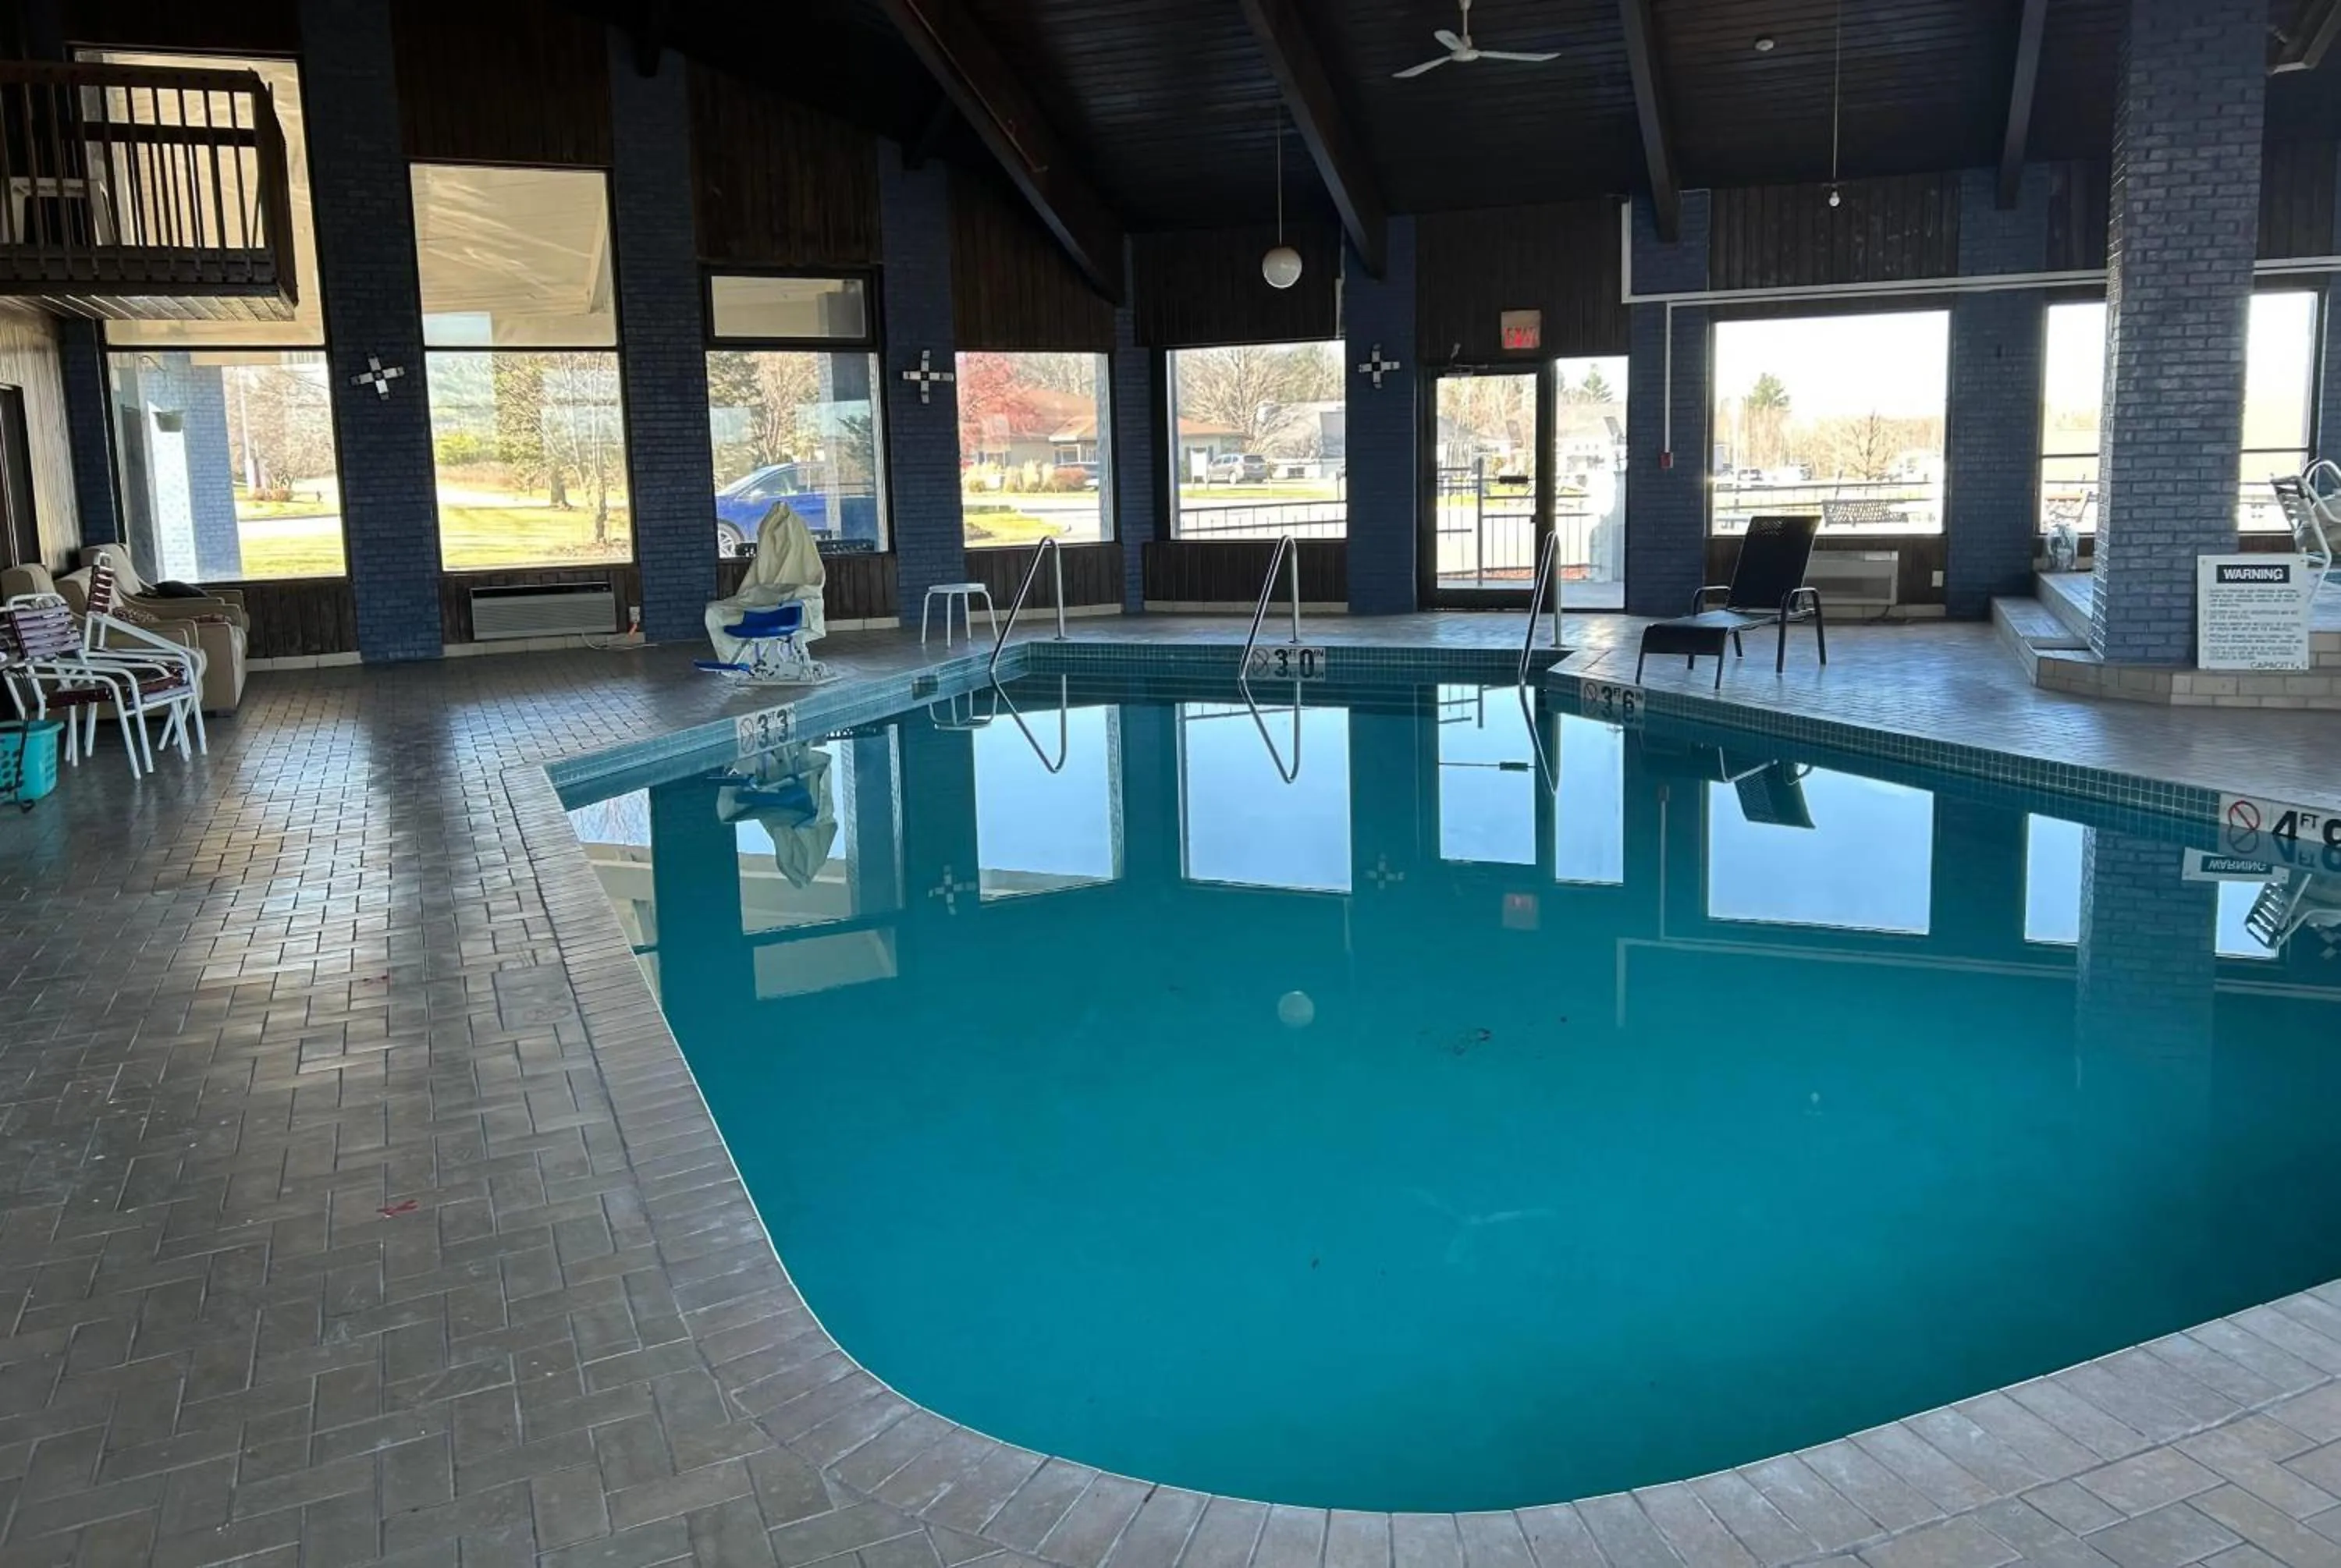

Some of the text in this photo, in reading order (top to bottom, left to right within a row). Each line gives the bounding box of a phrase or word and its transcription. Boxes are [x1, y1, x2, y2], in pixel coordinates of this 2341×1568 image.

[2223, 568, 2284, 580] WARNING
[2272, 810, 2299, 840] 4
[2300, 813, 2319, 829] FT
